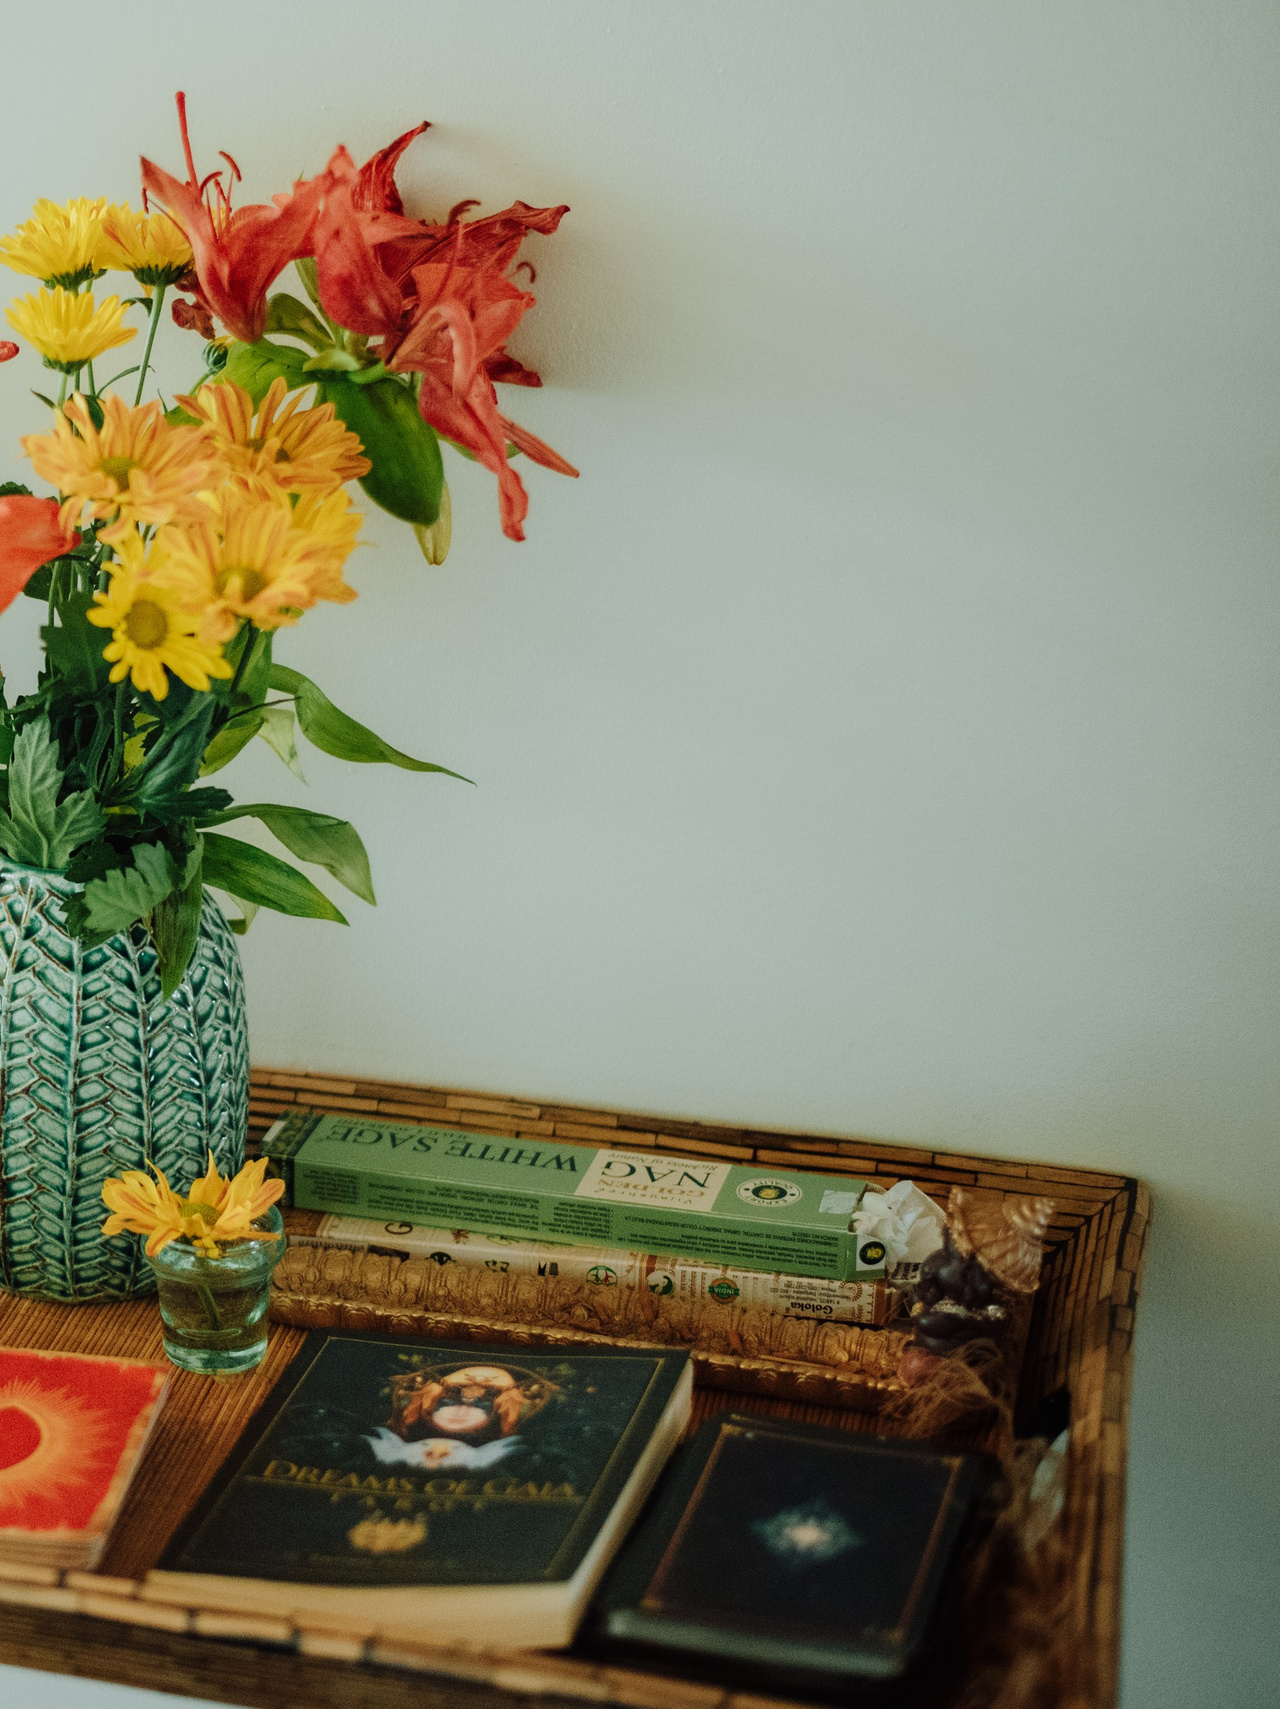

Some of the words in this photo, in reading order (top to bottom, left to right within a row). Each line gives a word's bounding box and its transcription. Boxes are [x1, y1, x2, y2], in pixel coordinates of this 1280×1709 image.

[325, 1123, 437, 1154] SAGE
[444, 1138, 579, 1172] WHITE
[599, 1159, 716, 1189] NAG
[597, 1178, 704, 1197] GOLDEN
[753, 1180, 792, 1189] QUALITY
[744, 1195, 787, 1205] EXPORT
[713, 1286, 734, 1294] INDIA
[789, 1301, 833, 1314] Goloka
[262, 1460, 414, 1492] DREAMS
[425, 1477, 469, 1495] OF
